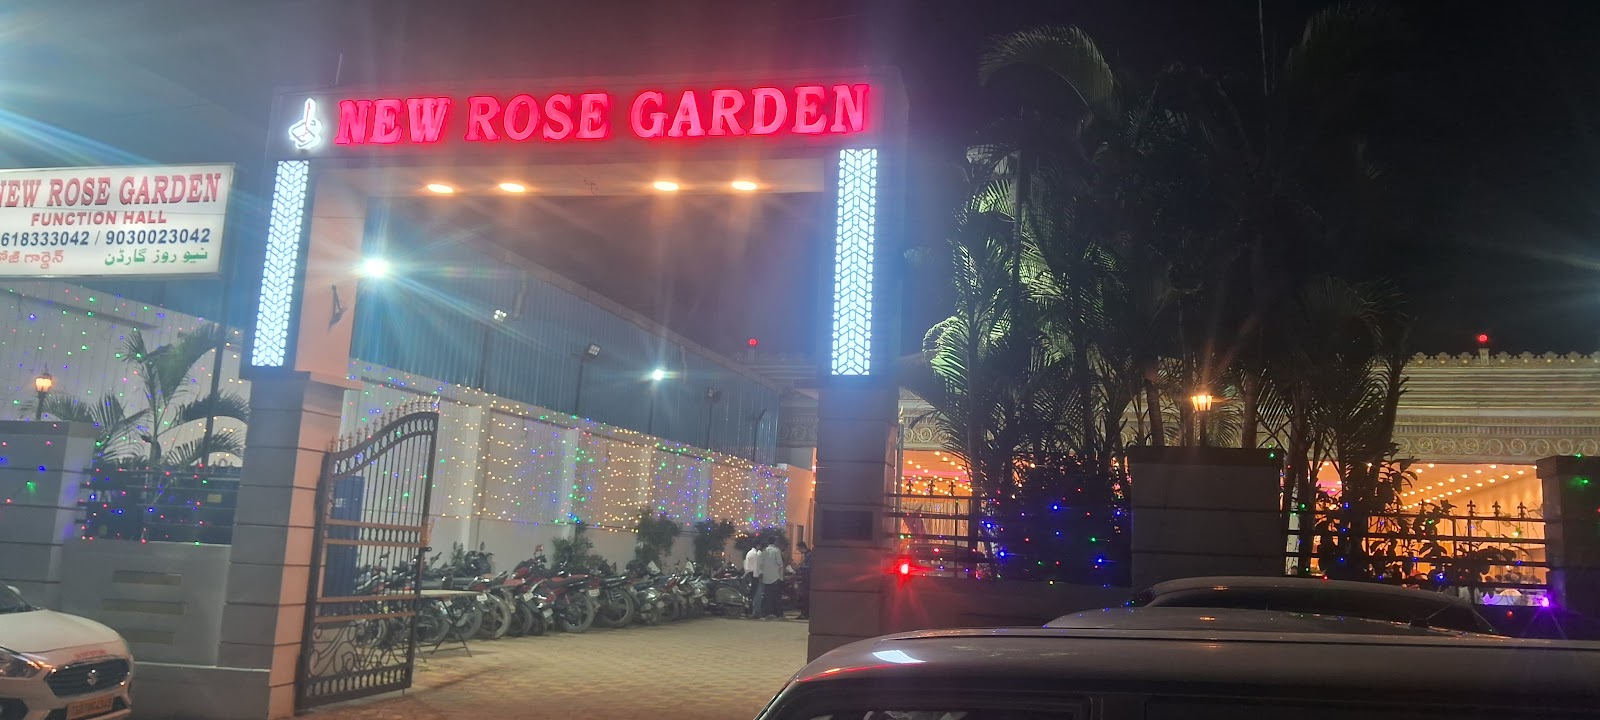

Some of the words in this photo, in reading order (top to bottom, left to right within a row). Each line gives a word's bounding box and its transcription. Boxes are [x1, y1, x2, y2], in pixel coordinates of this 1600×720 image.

[334, 97, 451, 145] NEW
[465, 93, 609, 142] ROSE
[629, 83, 870, 138] GARDEN
[47, 176, 111, 207] ROSE
[119, 172, 221, 206] GARDEN
[31, 211, 117, 227] FUNCTION
[123, 210, 167, 225] HALL
[105, 228, 211, 245] 9030023042
